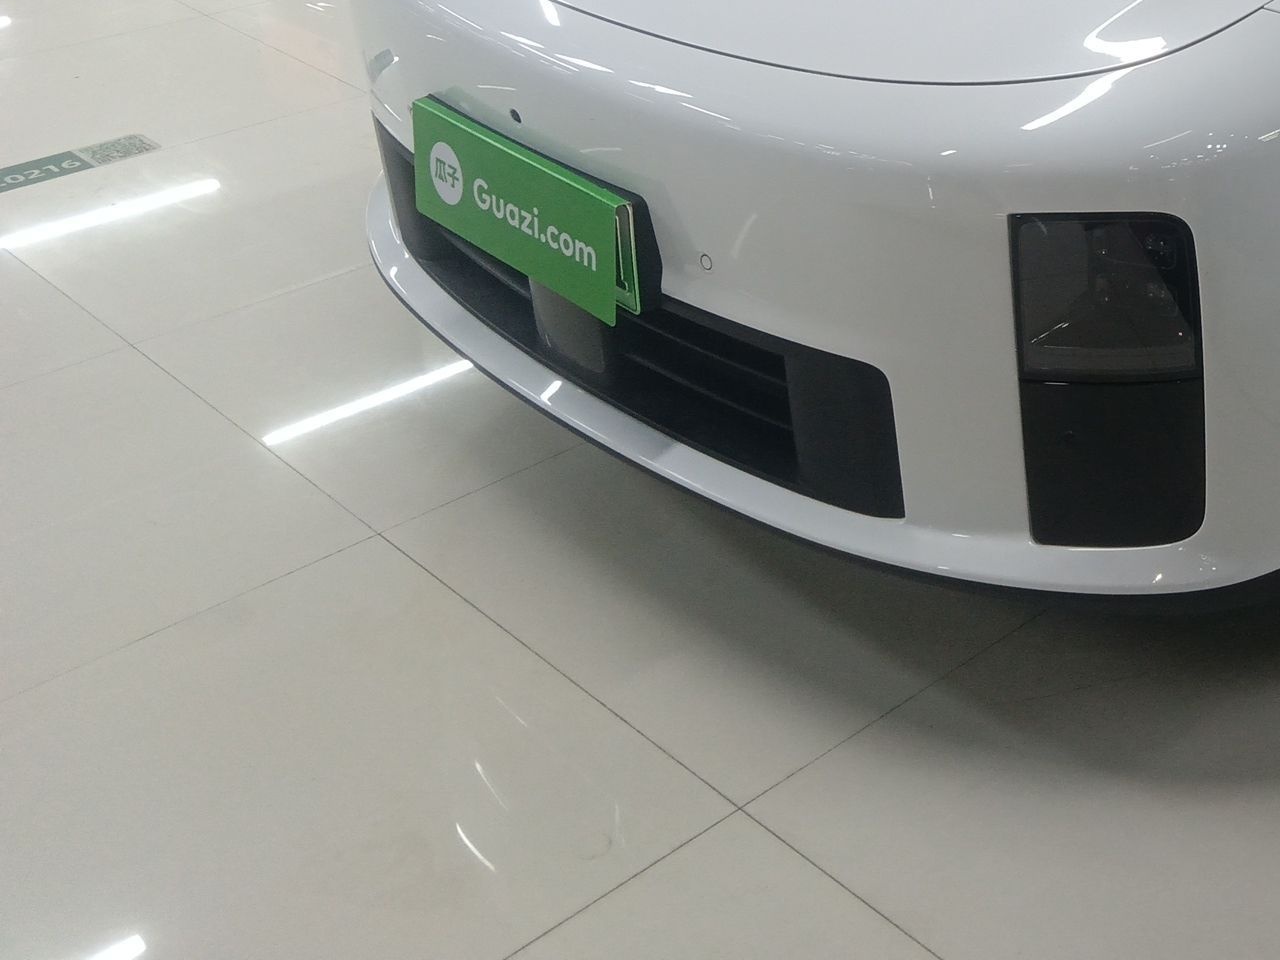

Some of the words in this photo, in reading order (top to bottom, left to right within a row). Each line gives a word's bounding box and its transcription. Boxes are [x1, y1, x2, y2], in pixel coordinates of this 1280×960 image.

[0, 158, 82, 188] 0216
[434, 156, 461, 189] 瓜子
[472, 177, 598, 272] Guazi.com
